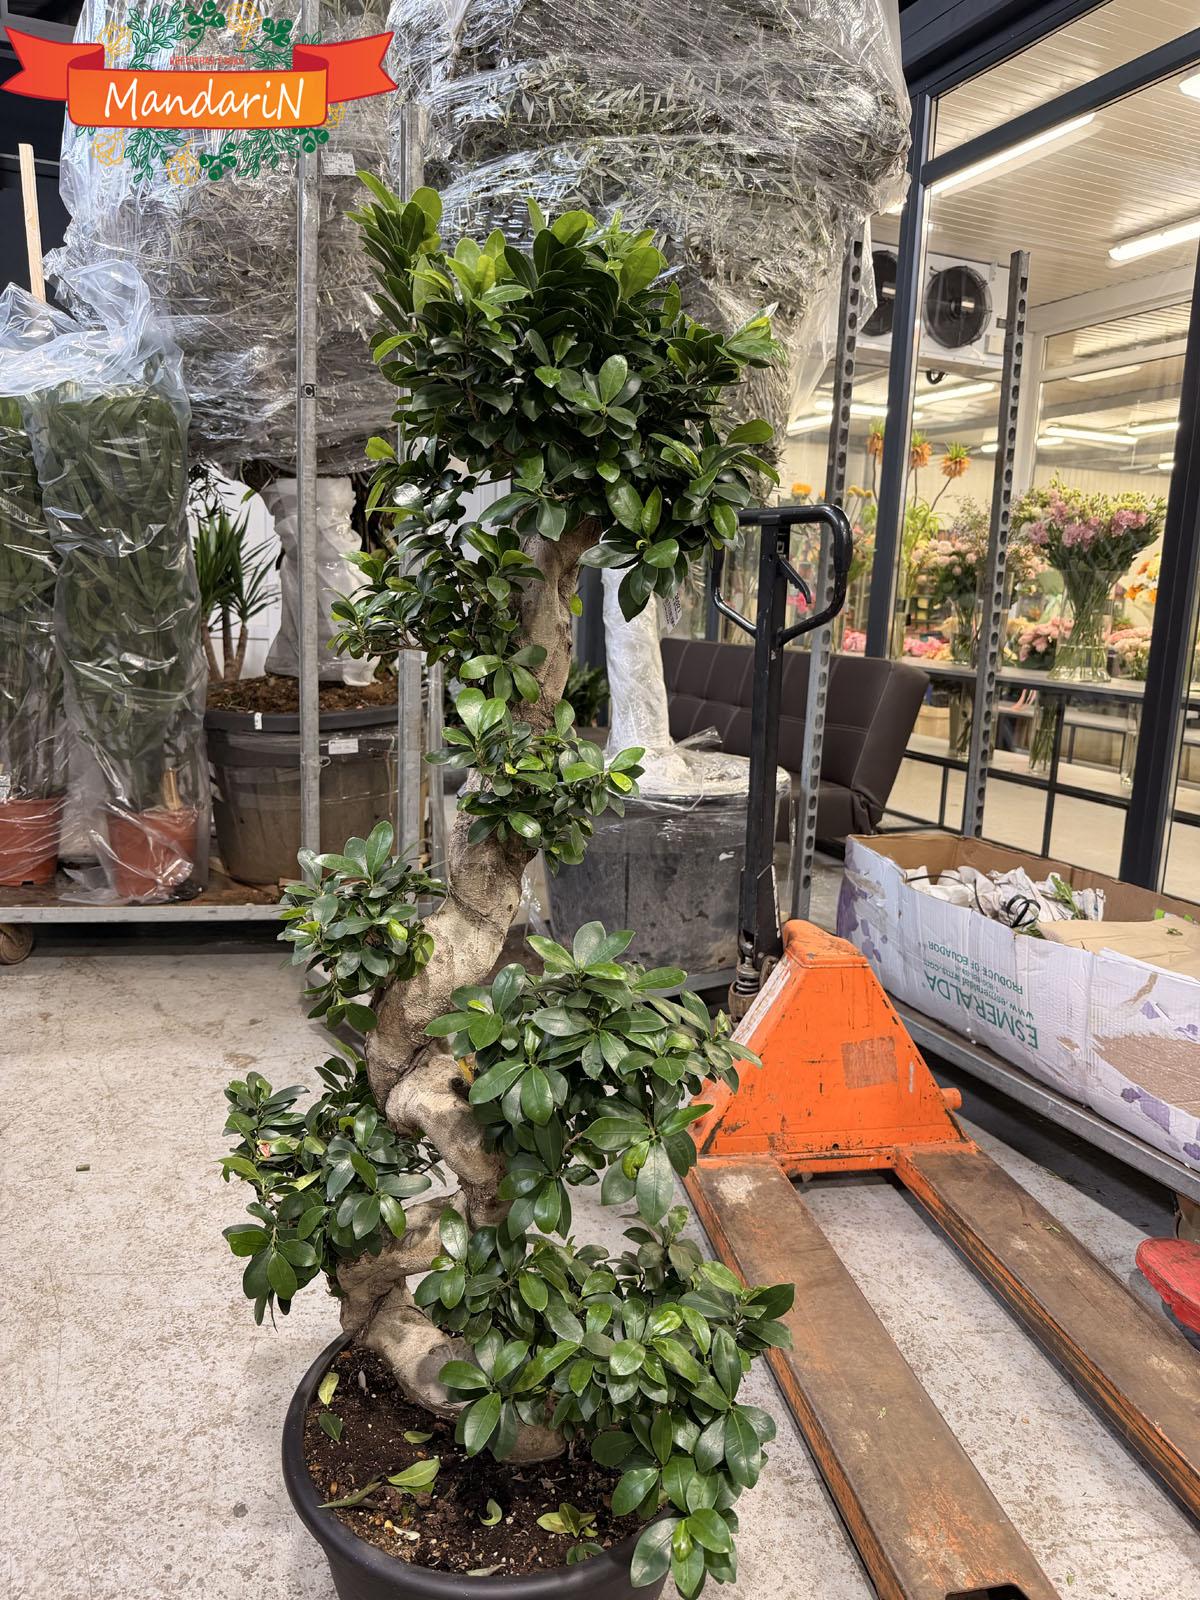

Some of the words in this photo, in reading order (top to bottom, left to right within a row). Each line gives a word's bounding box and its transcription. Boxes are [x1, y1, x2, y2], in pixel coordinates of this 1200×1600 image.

[927, 940, 969, 966] ECUADOR
[971, 961, 981, 973] OF
[982, 966, 1024, 995] PRODUCE
[924, 969, 1039, 1050] ESMERALDA
